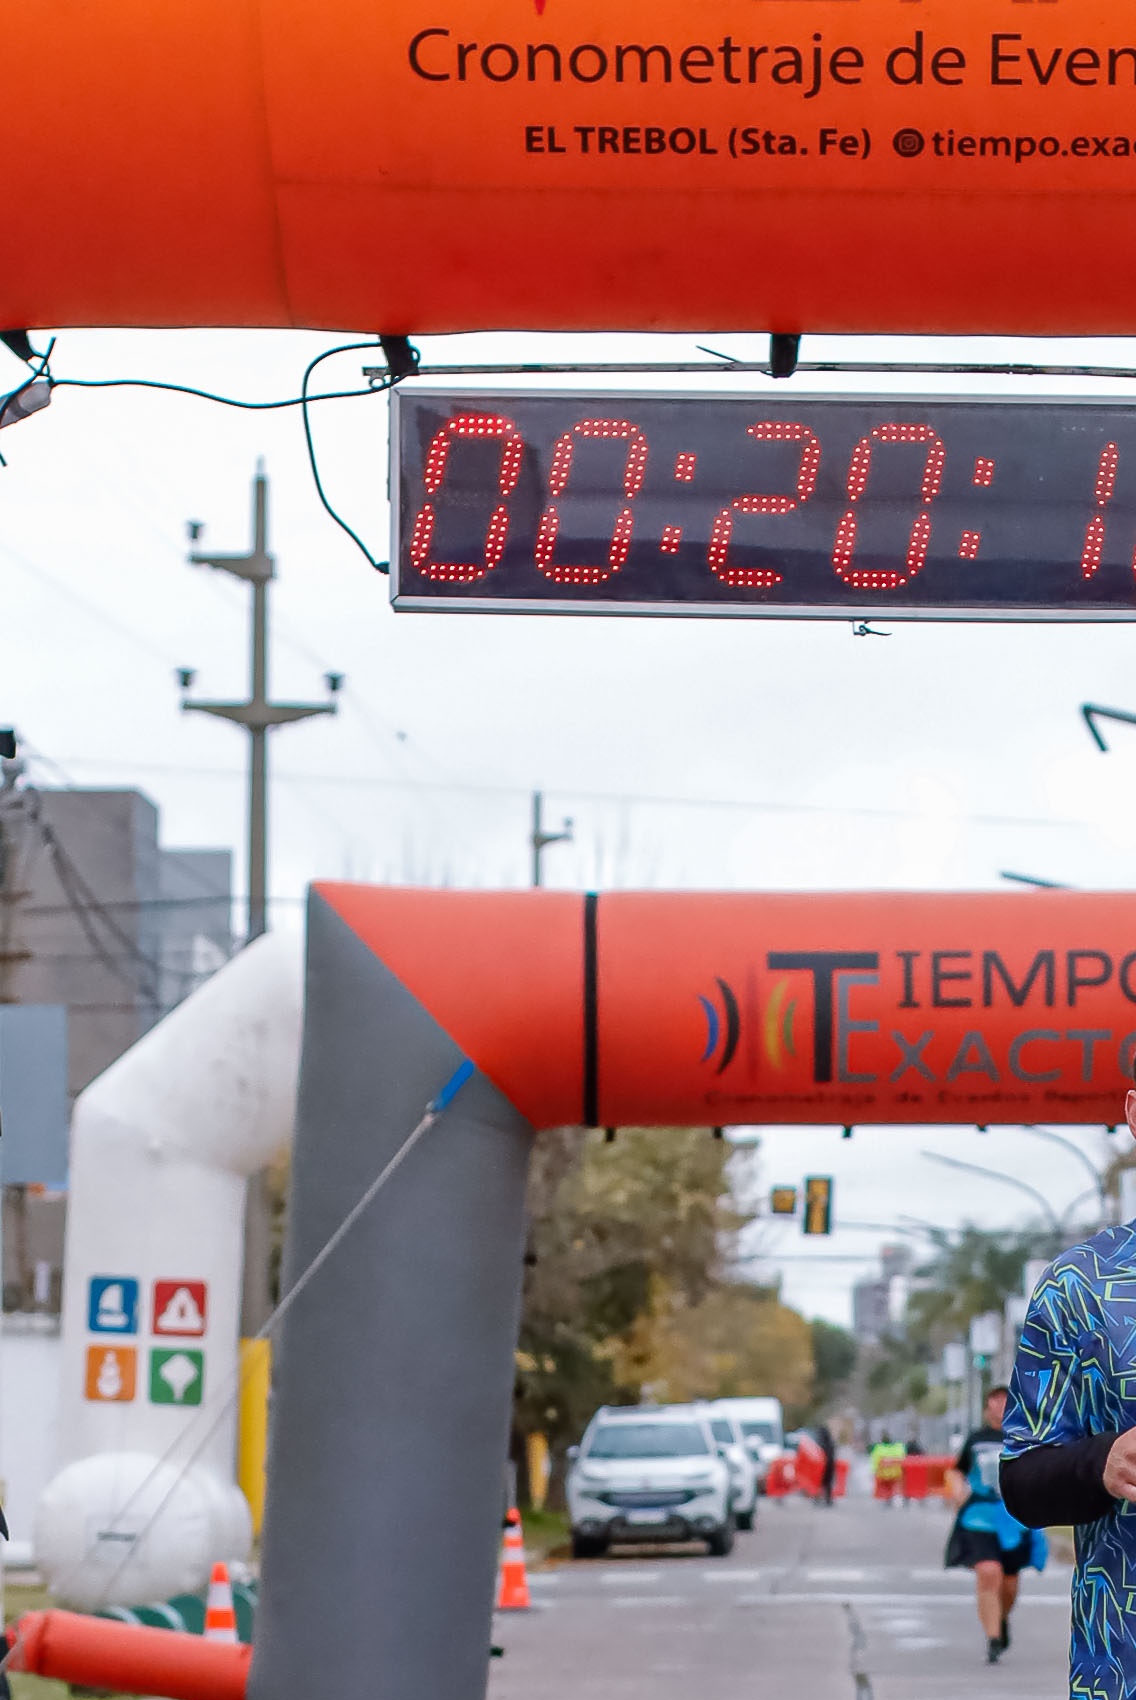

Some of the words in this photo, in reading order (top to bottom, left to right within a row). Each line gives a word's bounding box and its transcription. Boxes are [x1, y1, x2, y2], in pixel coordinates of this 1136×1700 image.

[408, 28, 864, 99] Cronometraje
[886, 30, 966, 86] de
[525, 126, 567, 153] EL
[573, 126, 718, 155] TREBOL
[728, 127, 808, 159] (Sta.
[819, 127, 871, 160] Fe)
